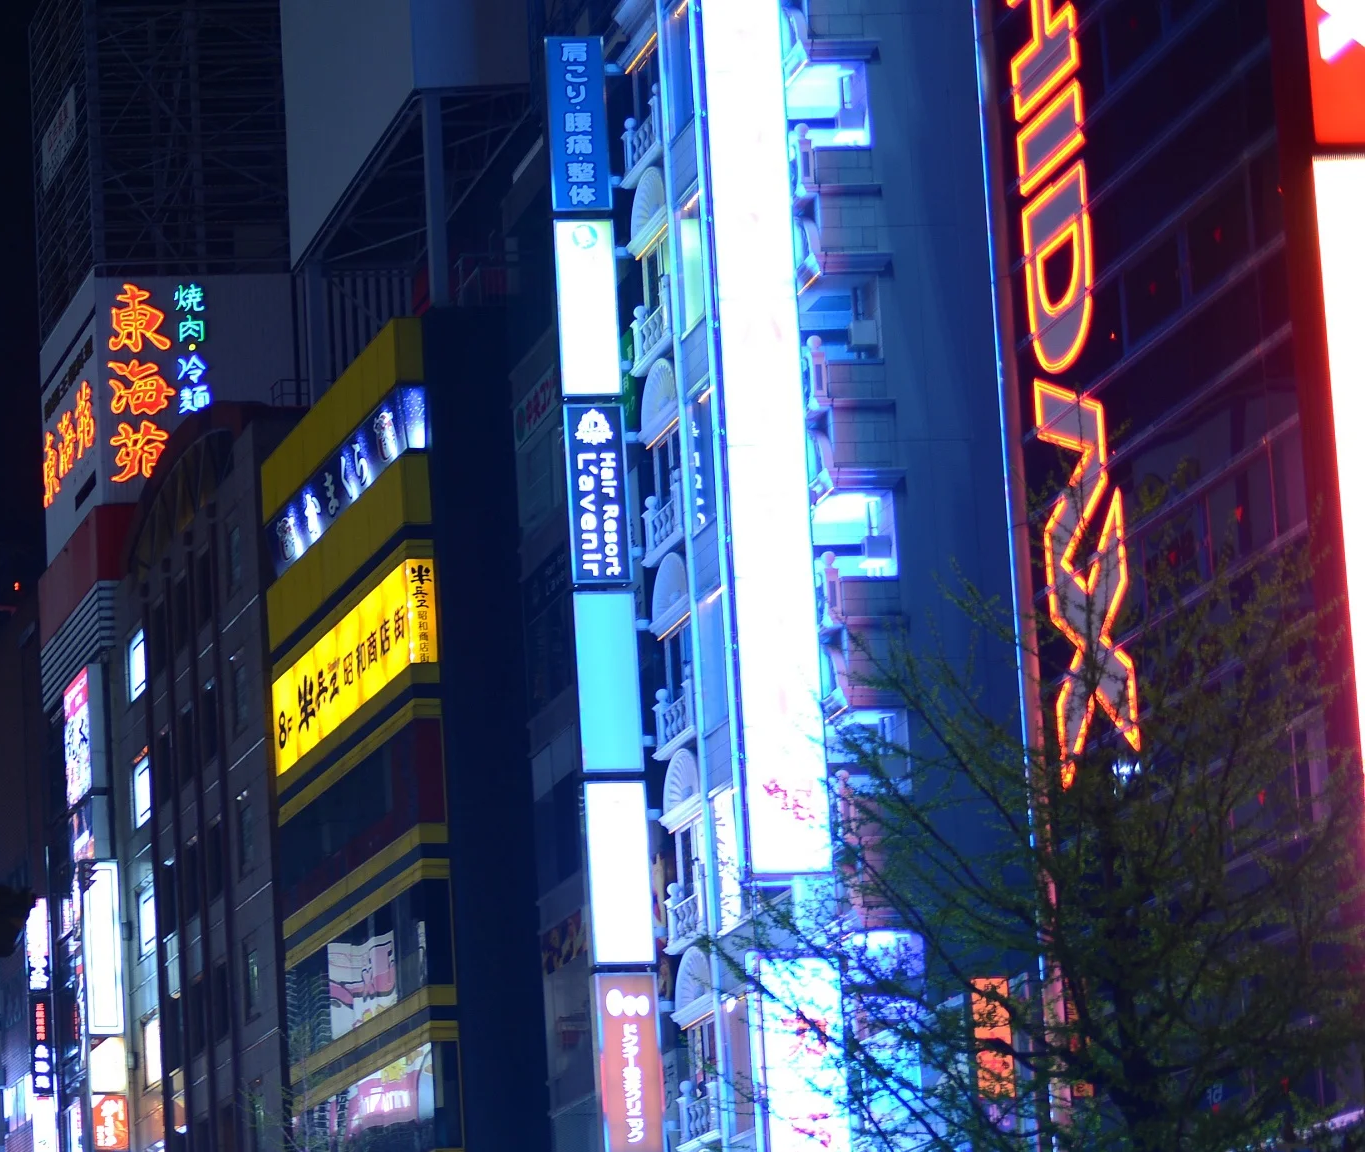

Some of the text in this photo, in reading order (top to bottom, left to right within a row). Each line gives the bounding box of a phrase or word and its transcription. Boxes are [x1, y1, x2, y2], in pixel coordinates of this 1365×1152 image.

[560, 41, 597, 207] 肩こり・腰痛・整体
[108, 282, 176, 484] 東海苑
[173, 283, 210, 413] 焼肉・冷麺
[42, 379, 96, 508] 東海苑
[302, 442, 369, 541] かまくら
[576, 452, 600, 578] L'avenir
[599, 452, 623, 578] Hair Resort
[342, 605, 406, 688] 昭和商店街
[416, 609, 431, 664] 昭和商店街
[277, 708, 294, 750] 8F
